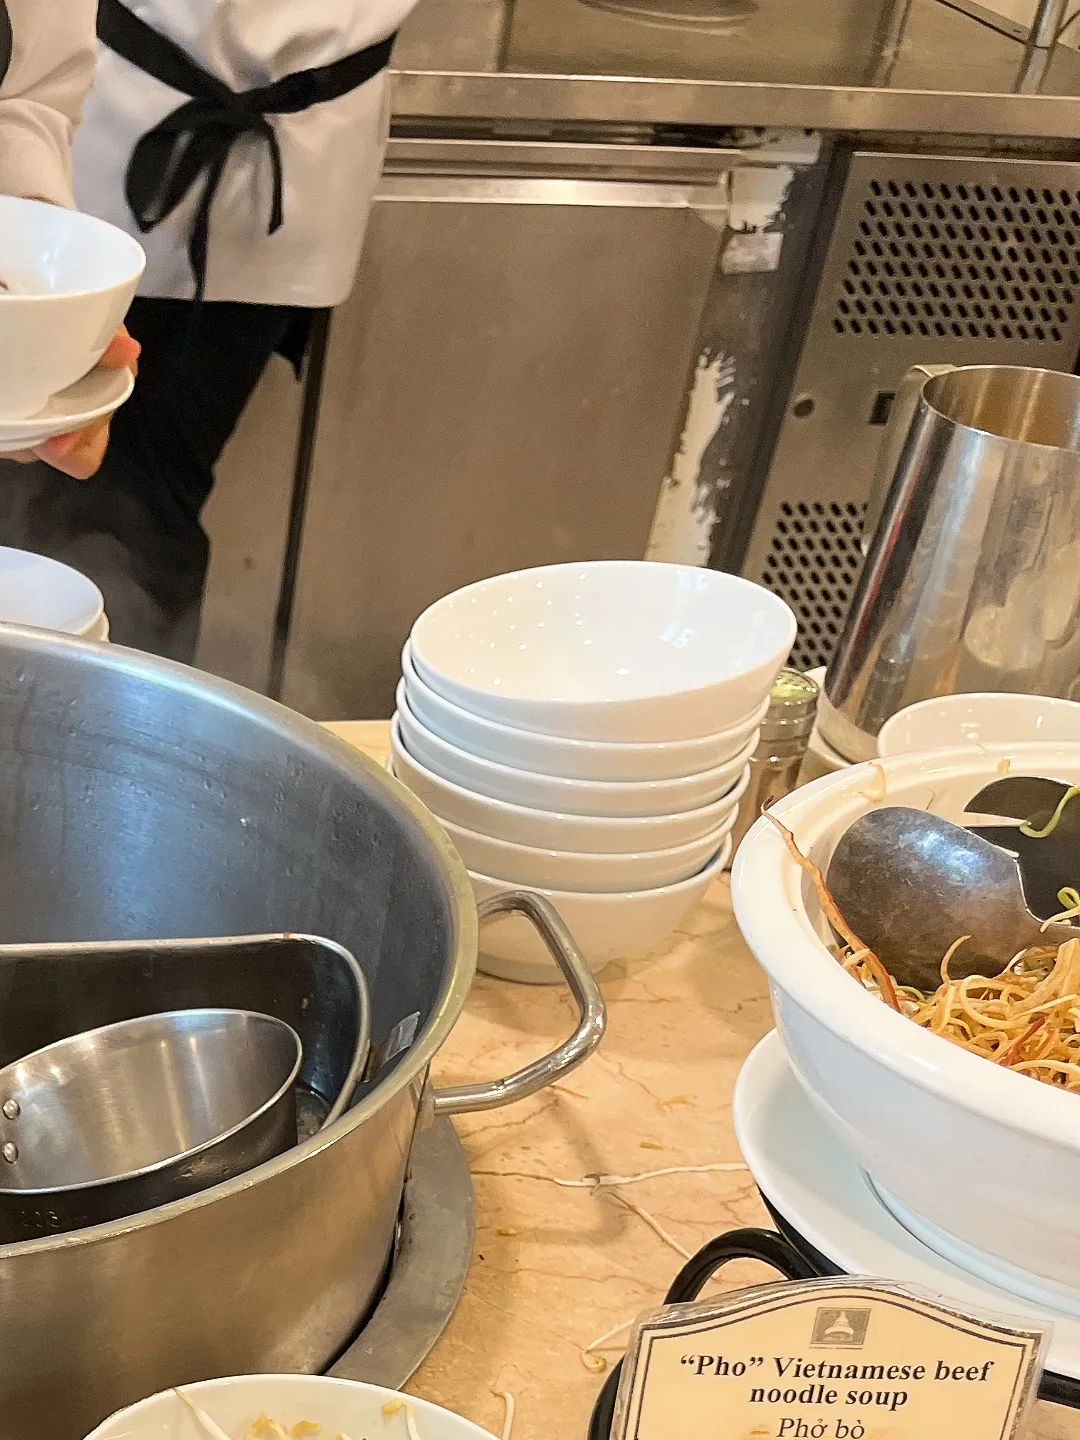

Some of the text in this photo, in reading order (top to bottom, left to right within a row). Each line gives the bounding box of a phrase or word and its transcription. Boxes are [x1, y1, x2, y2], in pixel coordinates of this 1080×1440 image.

[680, 1354, 995, 1382] “Pho” Vietnamese beef
[748, 1383, 908, 1412] noodle soup
[775, 1417, 865, 1440] Phở bò
